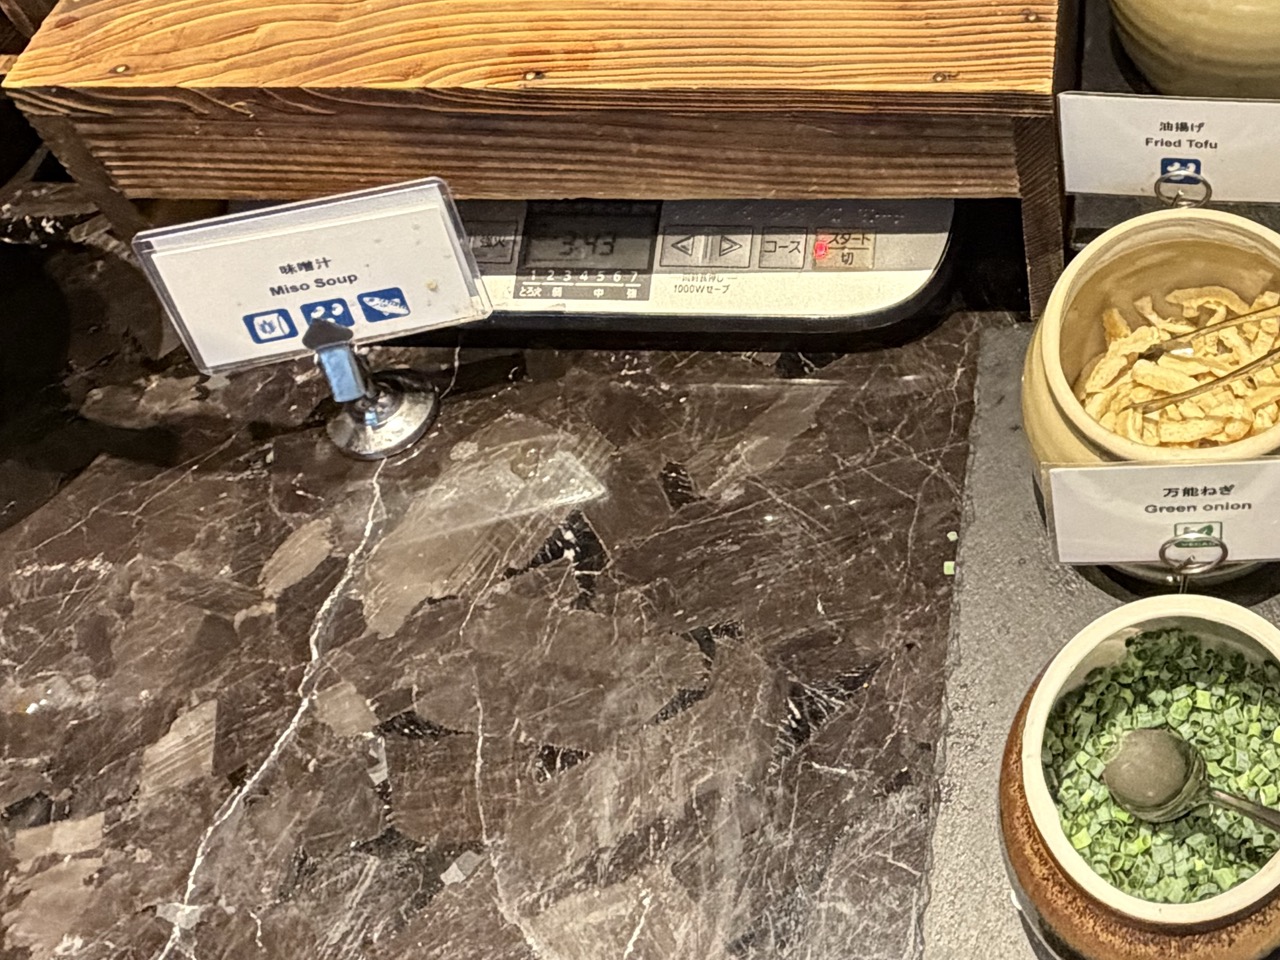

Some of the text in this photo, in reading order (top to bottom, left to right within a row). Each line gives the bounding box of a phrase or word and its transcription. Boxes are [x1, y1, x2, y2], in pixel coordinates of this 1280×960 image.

[1159, 121, 1206, 133] 油揚げ
[1145, 137, 1218, 150] Fried Tofu
[828, 232, 871, 246] スタート
[763, 240, 802, 254] コース
[841, 252, 854, 266] 切
[278, 257, 332, 276] 味噌汁
[546, 270, 555, 281] 2
[563, 270, 572, 281] 3
[579, 271, 588, 281] 4
[613, 271, 622, 282] 6
[269, 272, 359, 297] Miso Soup
[1163, 483, 1235, 498] 万能ねぎ
[1144, 501, 1253, 515] Green onion
